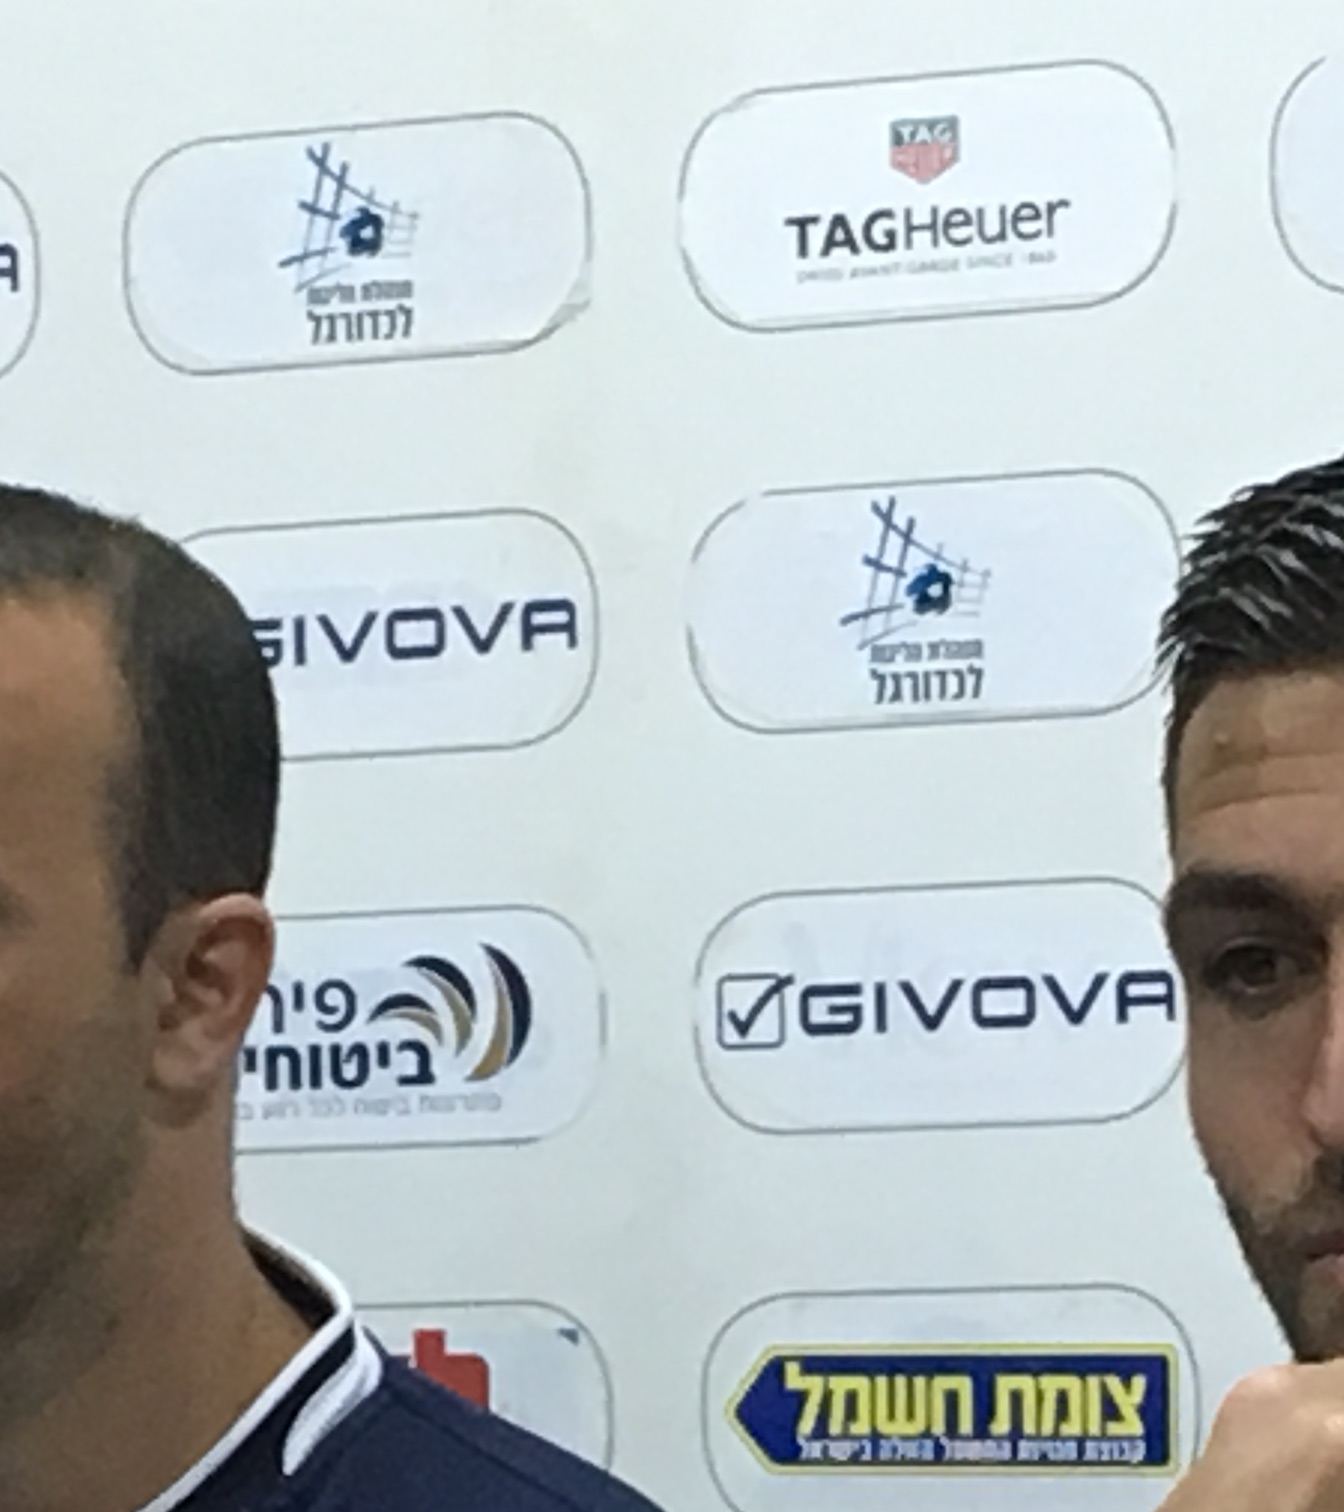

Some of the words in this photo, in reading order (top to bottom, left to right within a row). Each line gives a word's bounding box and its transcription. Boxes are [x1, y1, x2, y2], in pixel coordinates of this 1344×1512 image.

[898, 123, 953, 145] TAG
[869, 663, 984, 704] לכדורגל
[265, 979, 357, 1034] פיר
[799, 970, 1175, 1036] GIVOVA
[243, 1039, 435, 1091] ביטוחי
[784, 1361, 973, 1437] חשמל
[989, 1374, 1147, 1437] צומת
